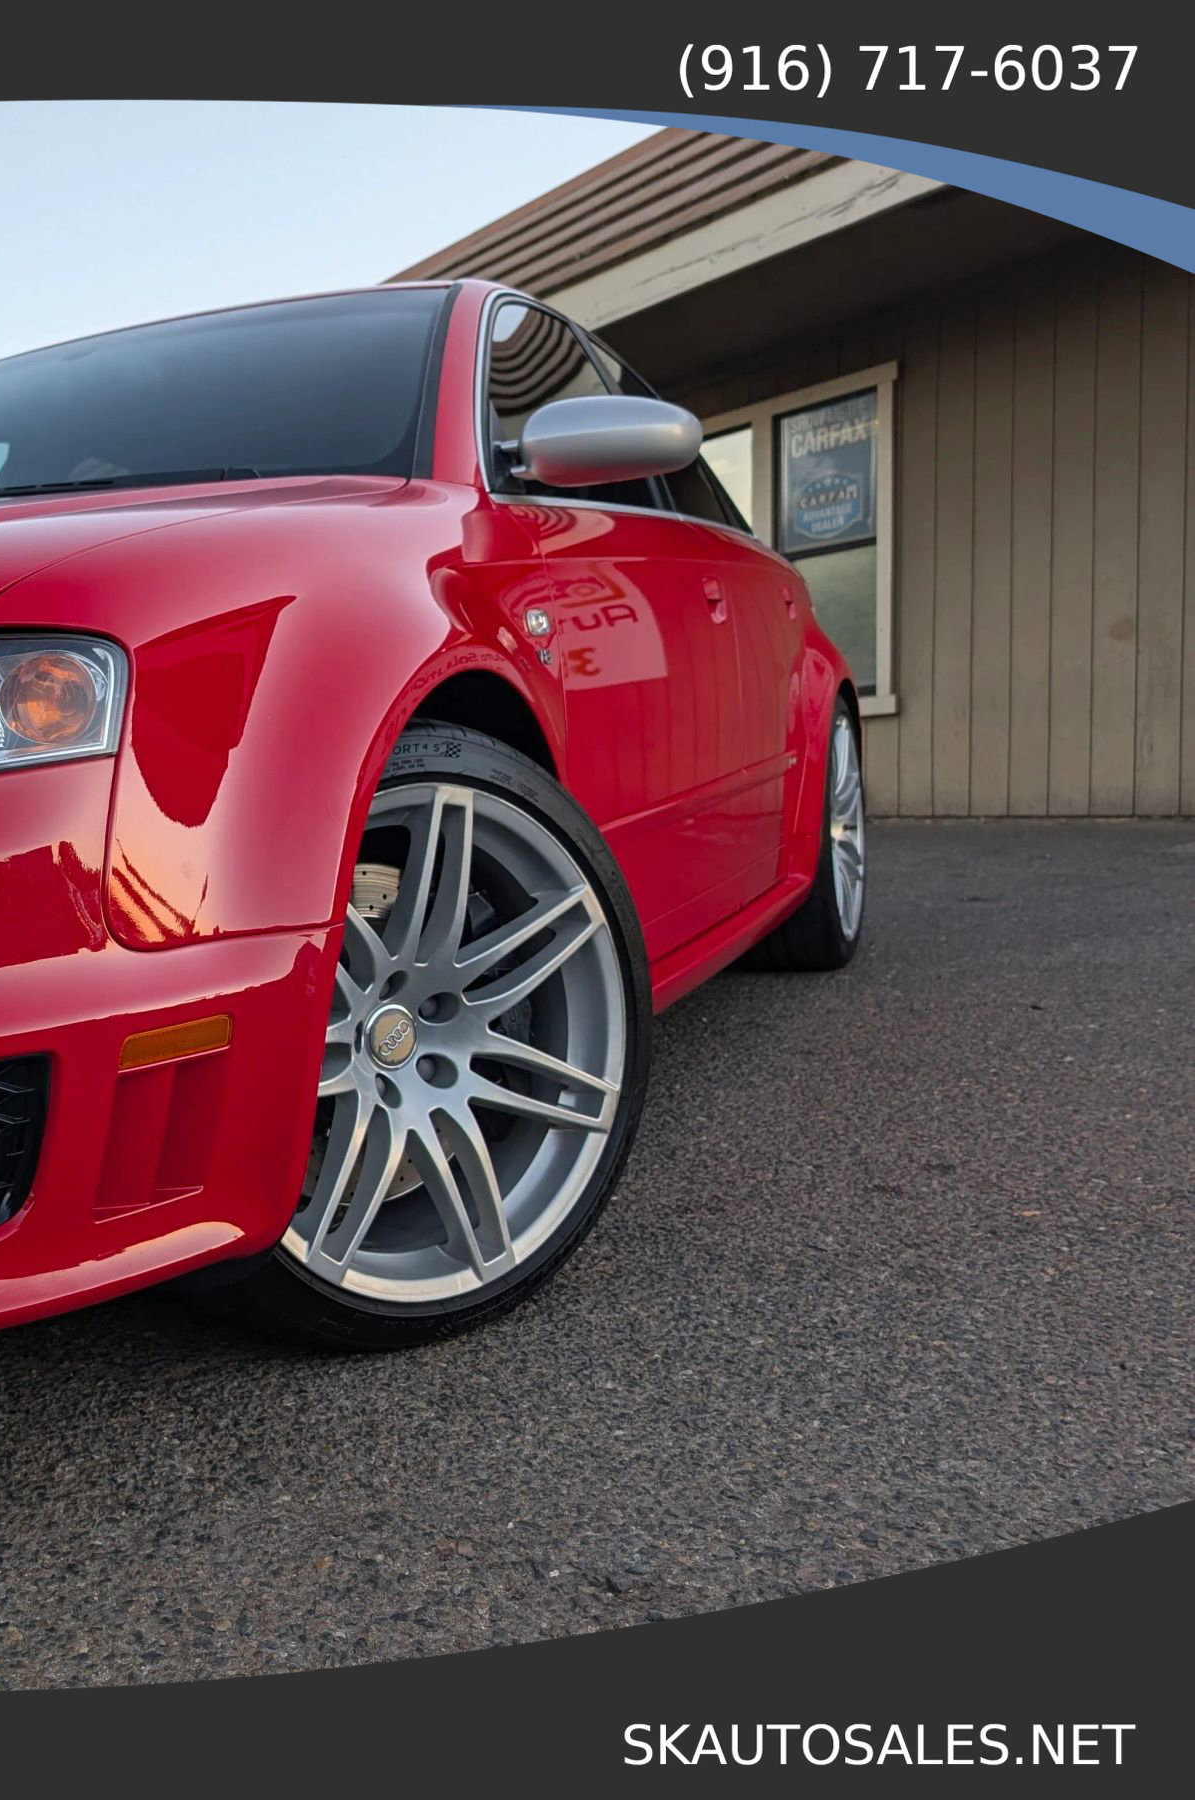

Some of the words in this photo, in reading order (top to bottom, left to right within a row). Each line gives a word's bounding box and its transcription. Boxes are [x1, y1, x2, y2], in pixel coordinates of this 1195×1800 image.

[791, 416, 869, 459] CARFAX
[392, 743, 420, 756] ORT
[433, 743, 440, 753] S
